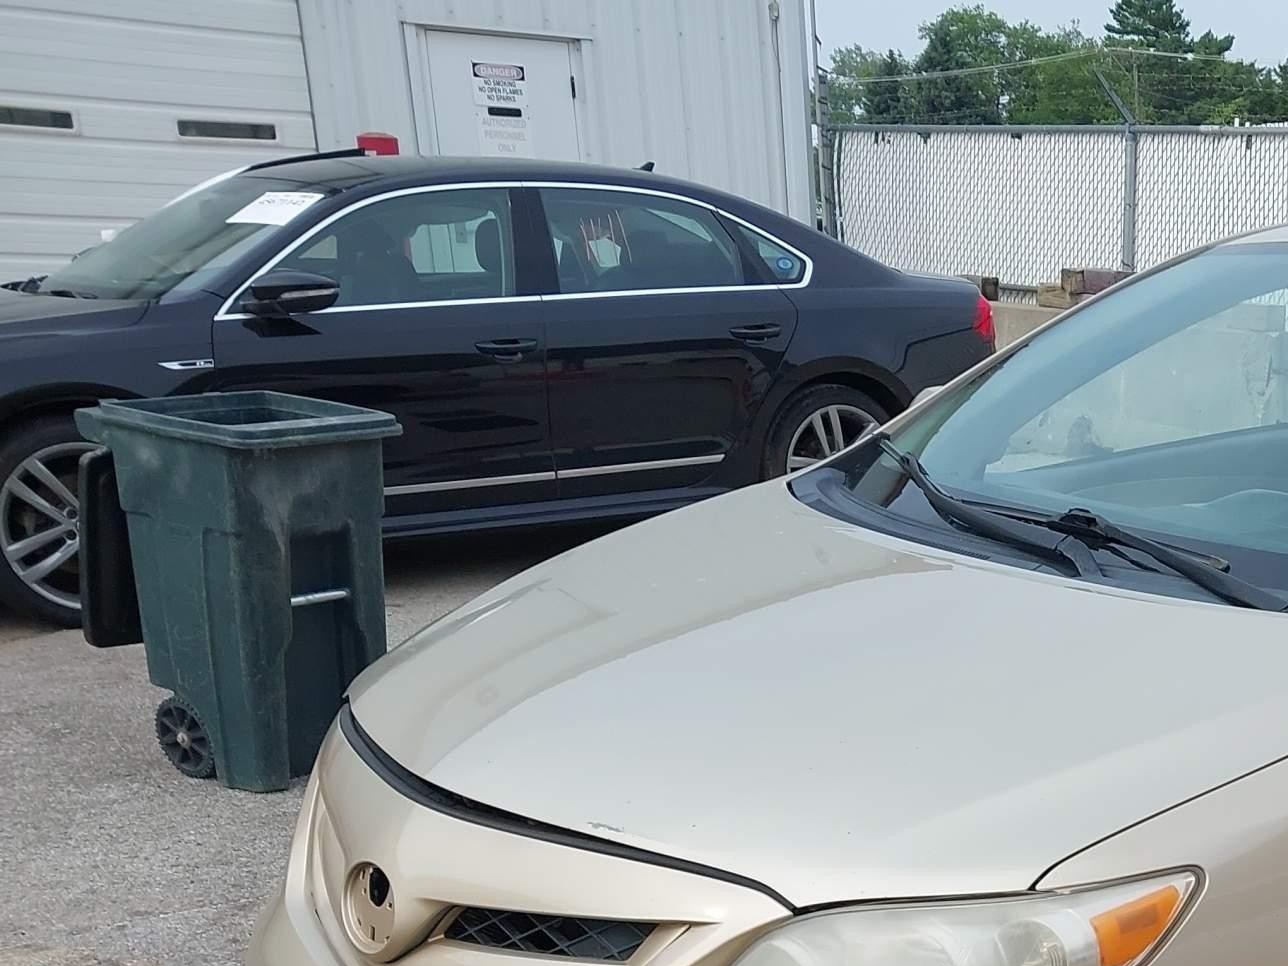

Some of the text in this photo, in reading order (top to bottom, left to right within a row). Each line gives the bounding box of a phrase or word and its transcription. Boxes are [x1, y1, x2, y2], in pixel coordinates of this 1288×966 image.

[481, 66, 517, 77] DANGER
[493, 80, 516, 88] SMOKING
[502, 88, 523, 96] FLAMES
[496, 95, 516, 103] SPARKS
[481, 118, 527, 128] AUTHORIZED
[484, 130, 526, 141] PERSONNEL
[498, 144, 517, 152] ONLY
